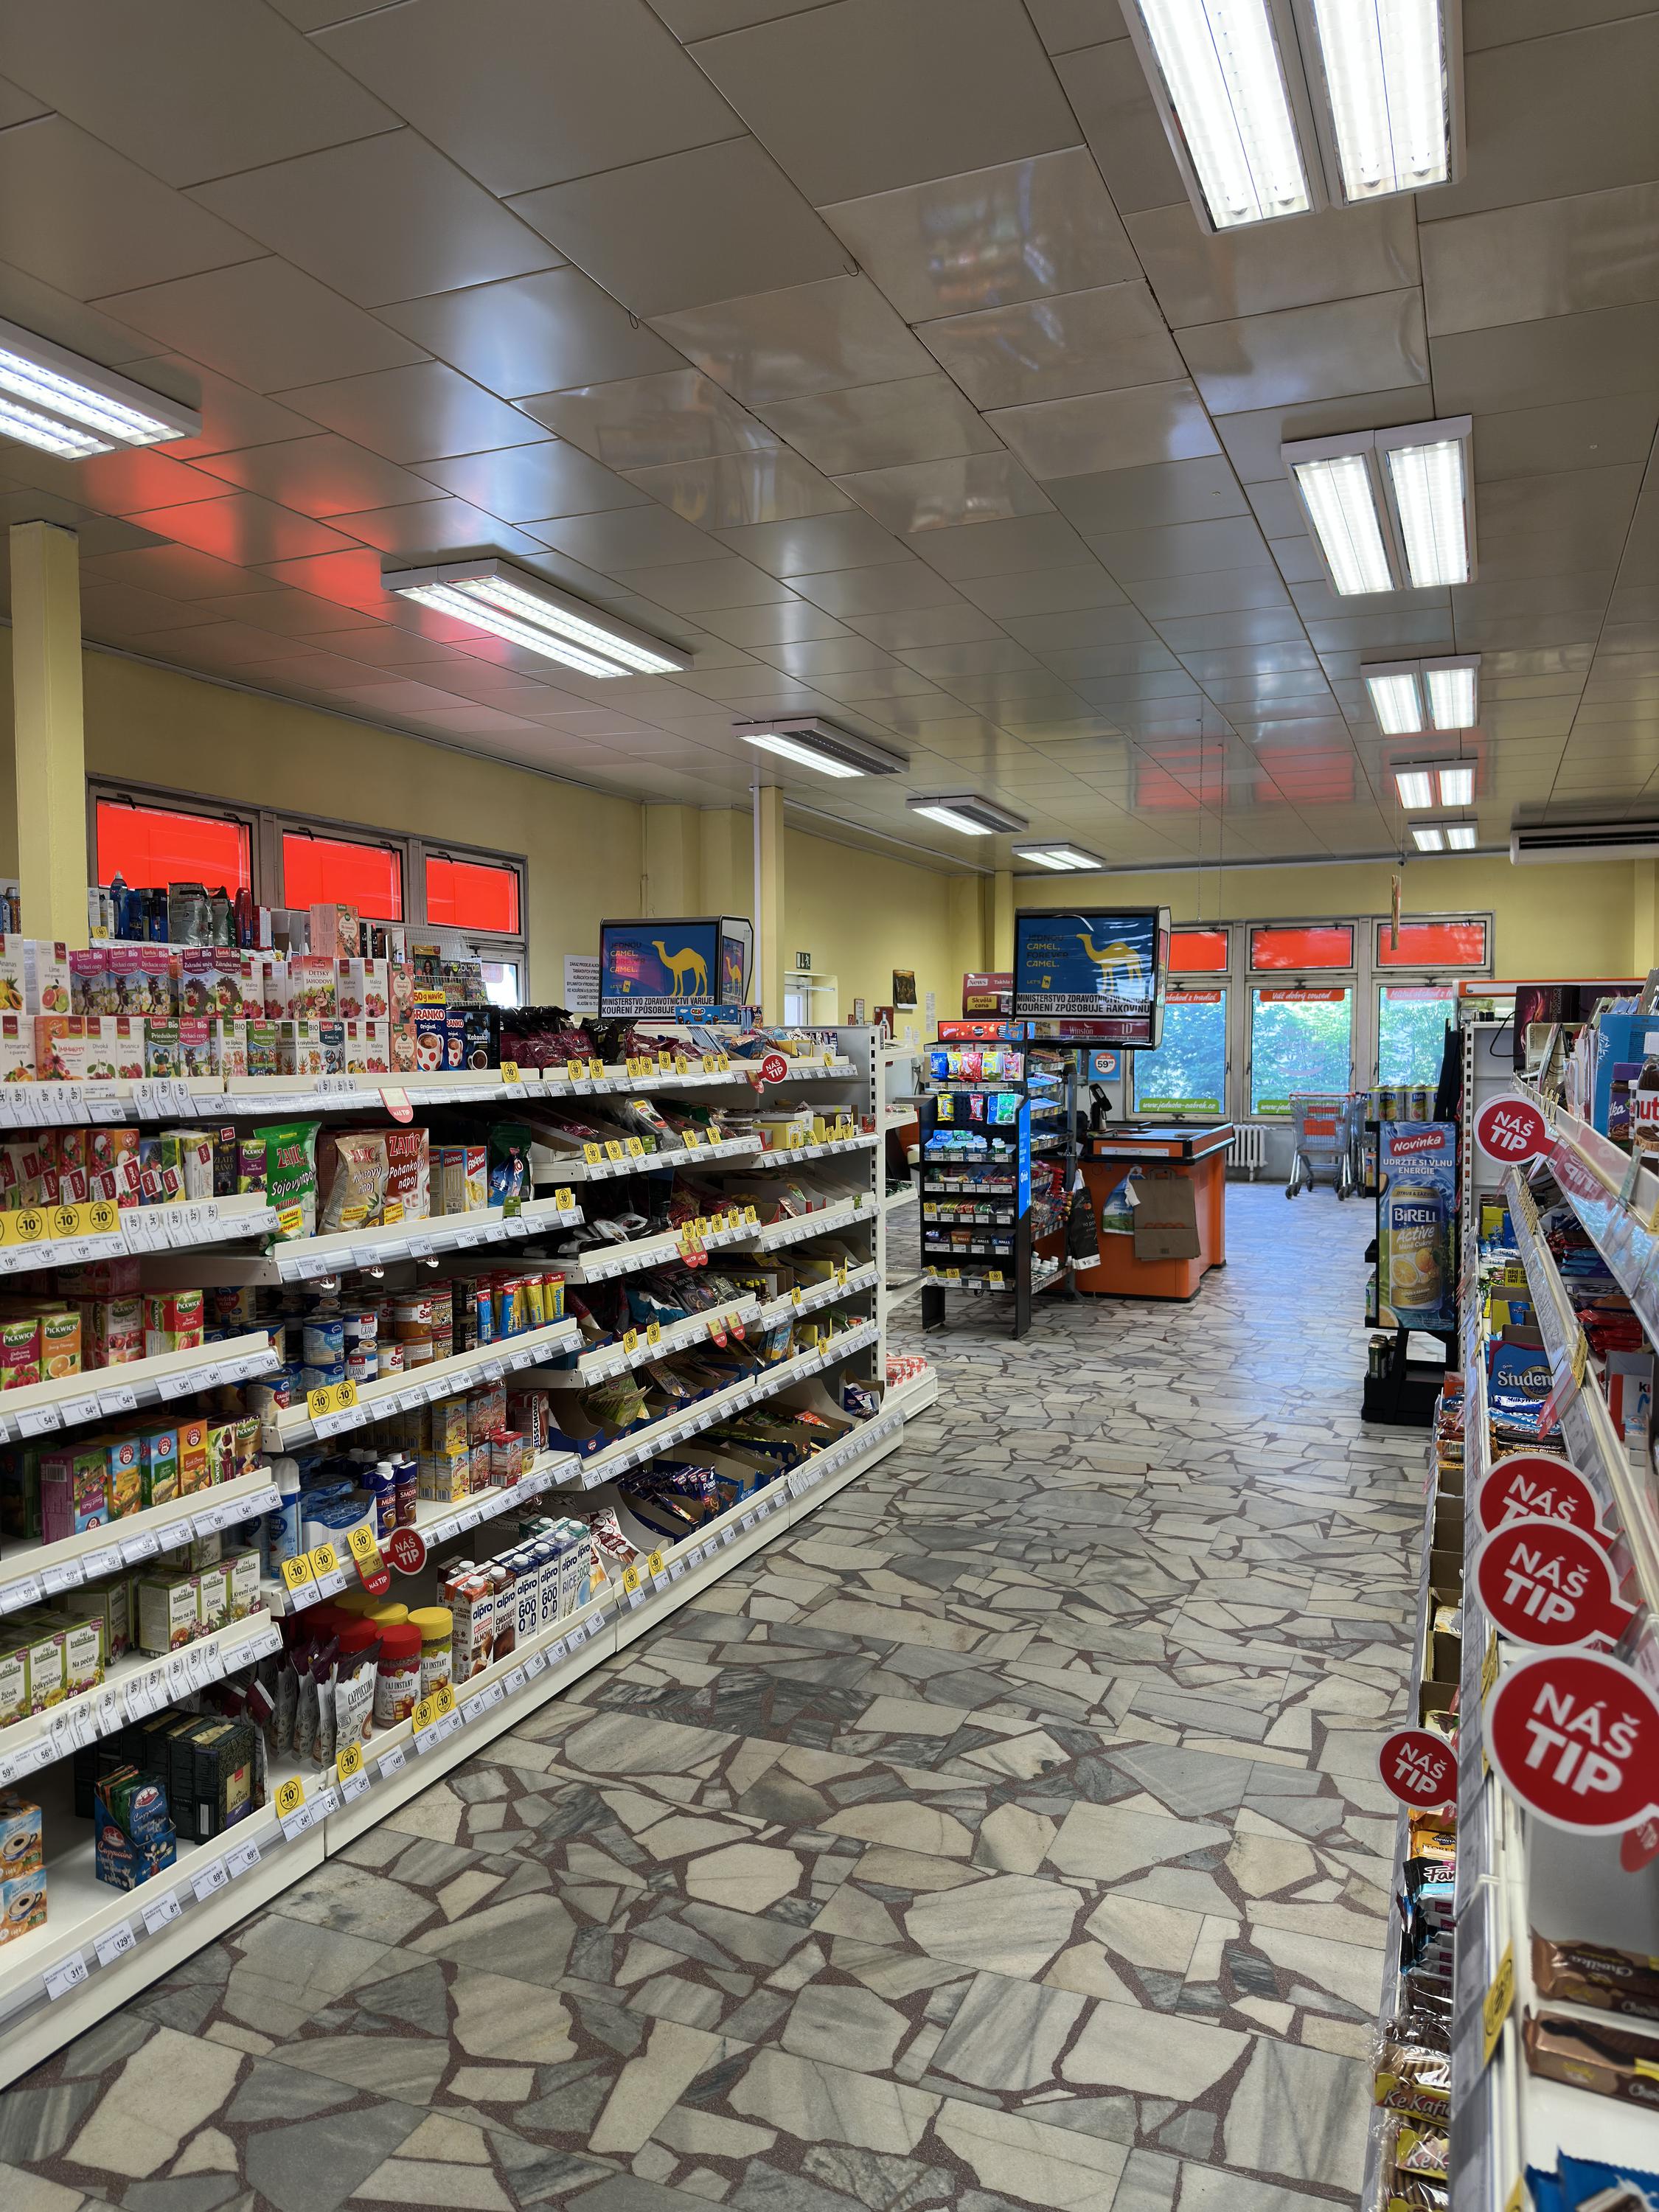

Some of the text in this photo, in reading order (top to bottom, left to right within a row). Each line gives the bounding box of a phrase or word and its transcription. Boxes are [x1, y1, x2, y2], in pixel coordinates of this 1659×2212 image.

[93, 952, 102, 960] Bio
[128, 950, 138, 958] Bio
[159, 950, 168, 959] Bio
[202, 949, 212, 958] Bio
[231, 950, 240, 959] Bio
[602, 998, 643, 1006] MINISTERSTVO
[644, 996, 689, 1006] ZDRAVOTNICTVÍ
[691, 997, 714, 1005] VARUJE:
[1017, 994, 1065, 1003] MINISTERSTVO
[602, 1005, 675, 1015] KOUŘENÍ ZPŮSOBUJE
[1017, 1002, 1150, 1013] KOUŘENÍ ZPŮSOBUJE RAKOVINU
[168, 1020, 178, 1029] Bio
[198, 1020, 207, 1029] Bio
[234, 1023, 246, 1031] BIO
[308, 1023, 319, 1032] BIO
[334, 1023, 343, 1032] Bio
[1069, 1024, 1093, 1035] Winston
[1121, 1023, 1133, 1034] LD
[765, 1058, 781, 1071] NÁŠ
[768, 1066, 784, 1079] TIP
[1494, 1110, 1536, 1136] NÁŠ
[389, 1132, 422, 1157] ZAJÍC
[1394, 1134, 1442, 1152] Novinka
[1490, 1125, 1528, 1152] TIP
[243, 1147, 265, 1156] PICKWICK
[389, 1158, 425, 1179] Pohankový
[1383, 1157, 1453, 1168] UDRŽTE SI VLNU
[1398, 1166, 1436, 1175] ENERGIE
[398, 1175, 417, 1190] nápoj
[1397, 1224, 1436, 1243] Active
[177, 1300, 201, 1311] PICKWICK
[44, 1323, 77, 1335] PICKWICK
[361, 1324, 375, 1335] GRAND
[3, 1332, 35, 1343] PICKWICK
[349, 1367, 366, 1377] GRAND
[1498, 1370, 1554, 1387] Studen
[236, 1425, 260, 1436] PICKWICK
[1508, 1474, 1579, 1523] NÁŠ
[394, 1536, 415, 1553] NÁŠ
[399, 1550, 420, 1566] TIP
[562, 1555, 577, 1571] alpro
[540, 1567, 558, 1583] alpro
[1509, 1542, 1590, 1599] NÁŠ
[369, 1575, 388, 1590] NÁŠ TIP
[518, 1579, 538, 1596] alpro
[563, 1578, 577, 1595] RICE
[234, 1588, 249, 1598] Krevní
[1502, 1568, 1576, 1625] TIP
[496, 1592, 515, 1609] alpro
[172, 1614, 183, 1623] Zmes
[473, 1603, 493, 1621] alpro
[495, 1607, 515, 1625] CHOCOLATE
[71, 1633, 96, 1648] bylinkára
[473, 1629, 493, 1645] ALMOND
[35, 1649, 58, 1663] bylinkára
[72, 1655, 95, 1669] Na pečeň
[429, 1658, 447, 1669] INSTANT
[32, 1674, 61, 1691] Odkyslenie
[396, 1678, 413, 1688] INSTANT
[348, 1678, 374, 1705] CAPPUCCINO
[1532, 1681, 1643, 1760] NÁŠ
[1399, 1742, 1448, 1779] NÁŠ
[1524, 1718, 1624, 1797] TIP
[1394, 1756, 1439, 1795] TIP
[229, 1792, 248, 1808] JACOBS
